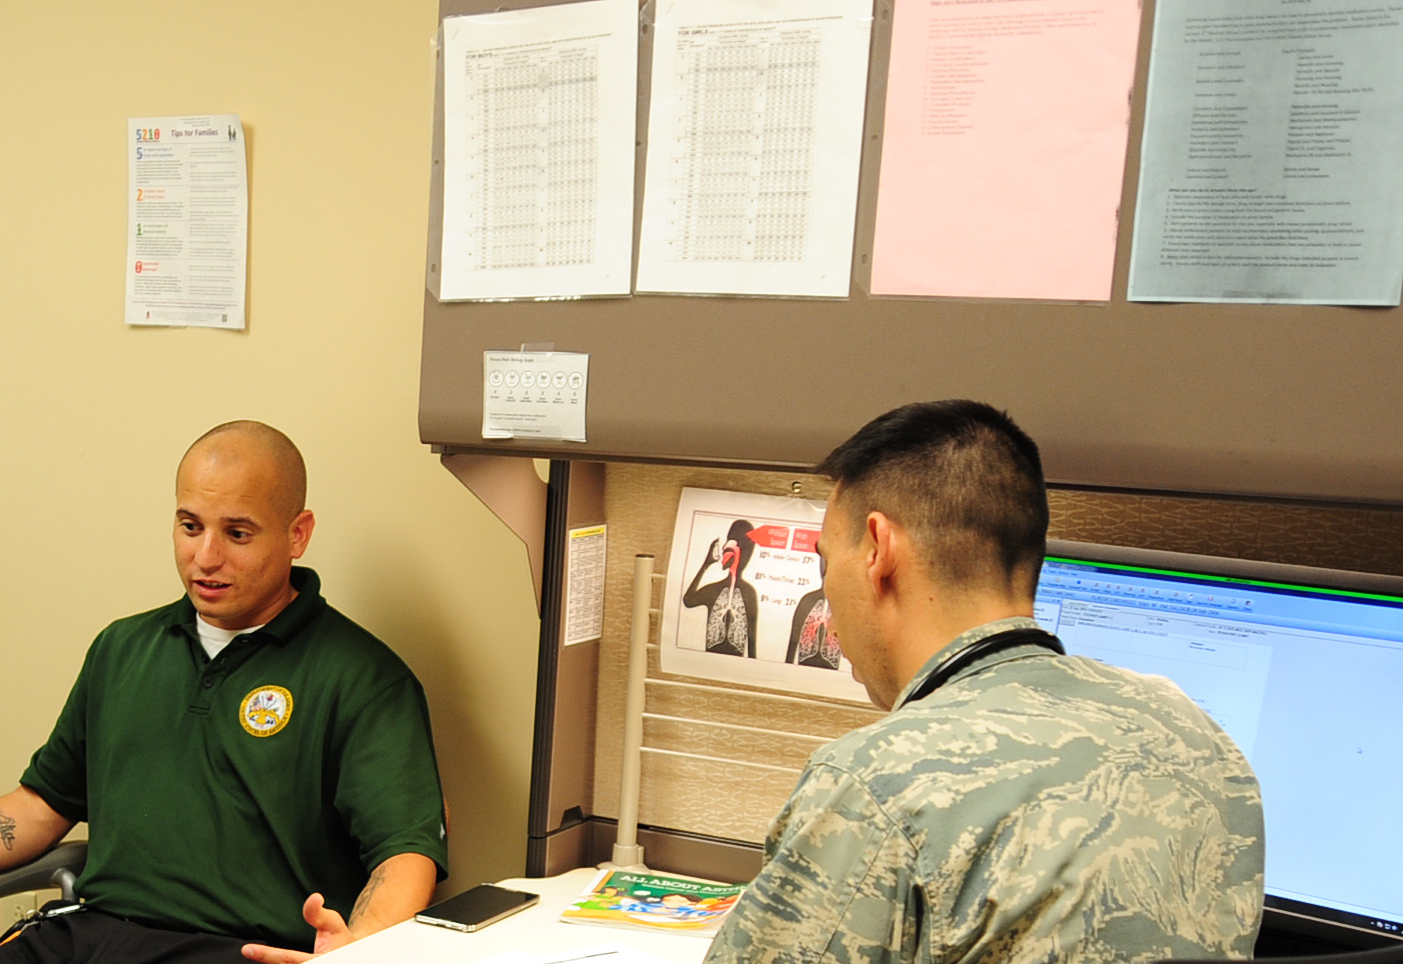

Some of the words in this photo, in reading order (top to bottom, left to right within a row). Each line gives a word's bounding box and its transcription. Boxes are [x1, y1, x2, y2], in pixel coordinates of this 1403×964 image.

[136, 128, 160, 140] 5210
[171, 129, 183, 137] Tips
[136, 147, 143, 160] 5
[136, 188, 143, 201] 2
[137, 223, 142, 236] 1
[620, 875, 649, 884] ALL
[649, 879, 701, 891] ABOUT
